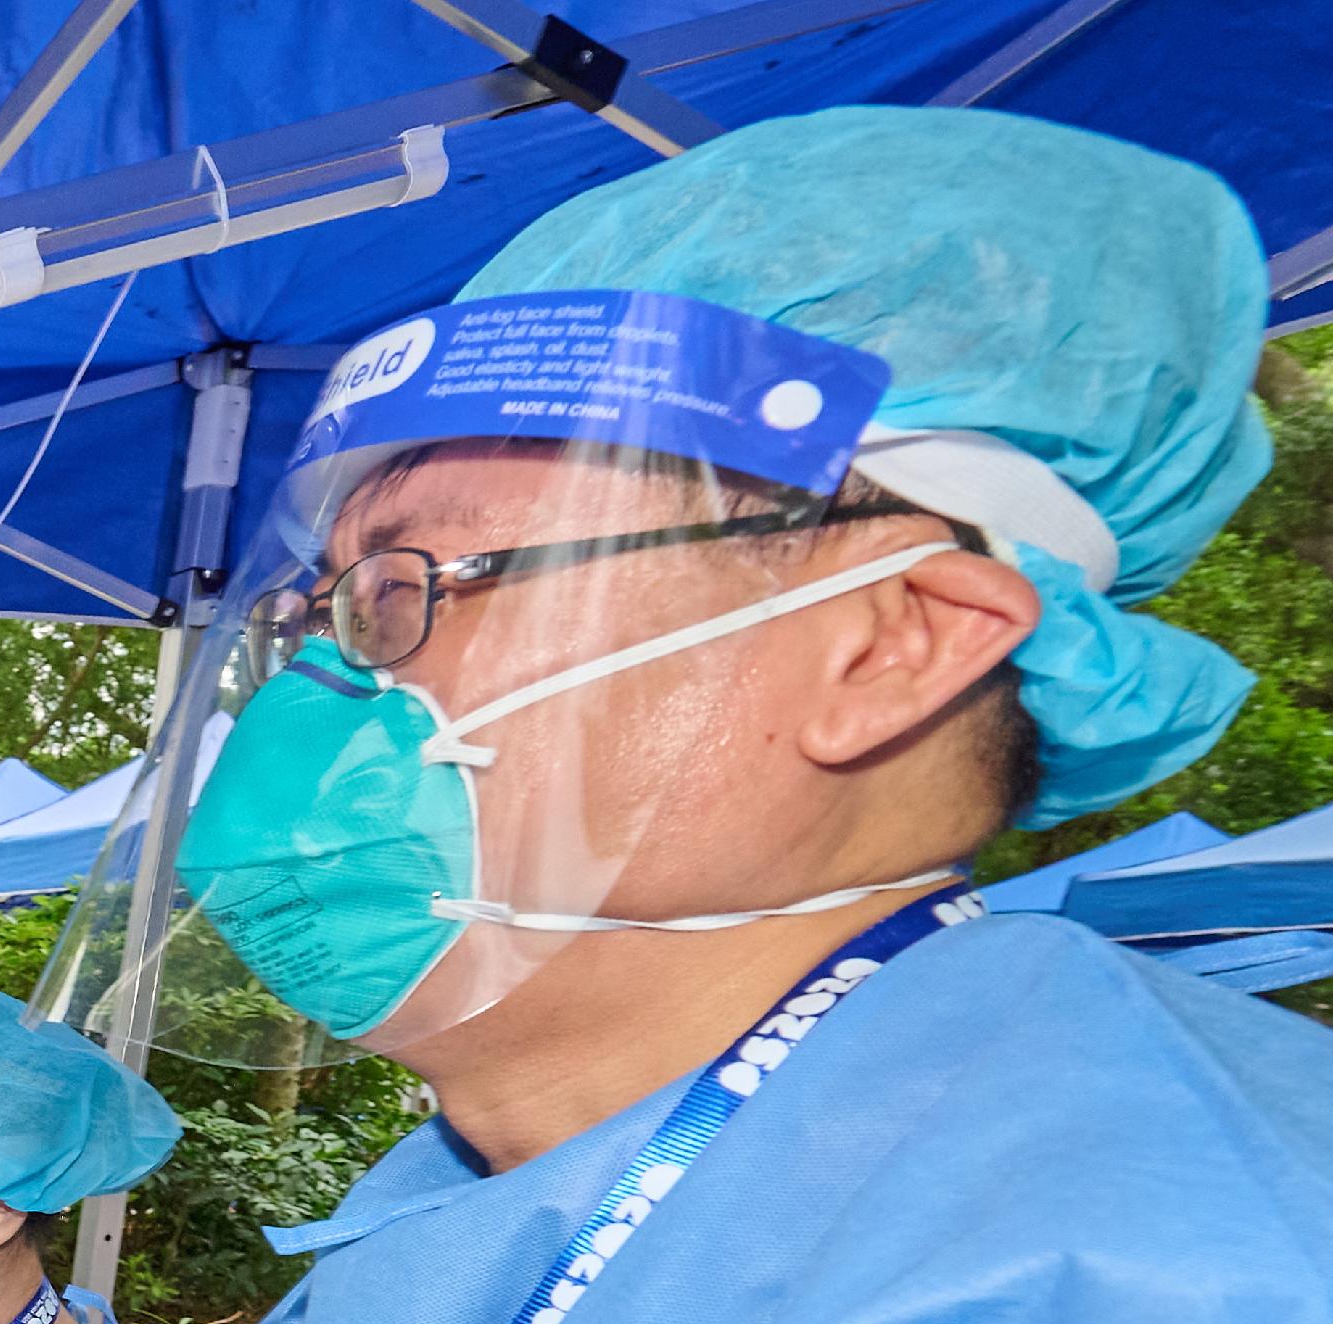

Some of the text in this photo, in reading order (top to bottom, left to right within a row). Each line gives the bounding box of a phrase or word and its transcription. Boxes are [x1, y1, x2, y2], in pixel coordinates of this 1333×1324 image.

[500, 401, 620, 421] MADE IN CHINA
